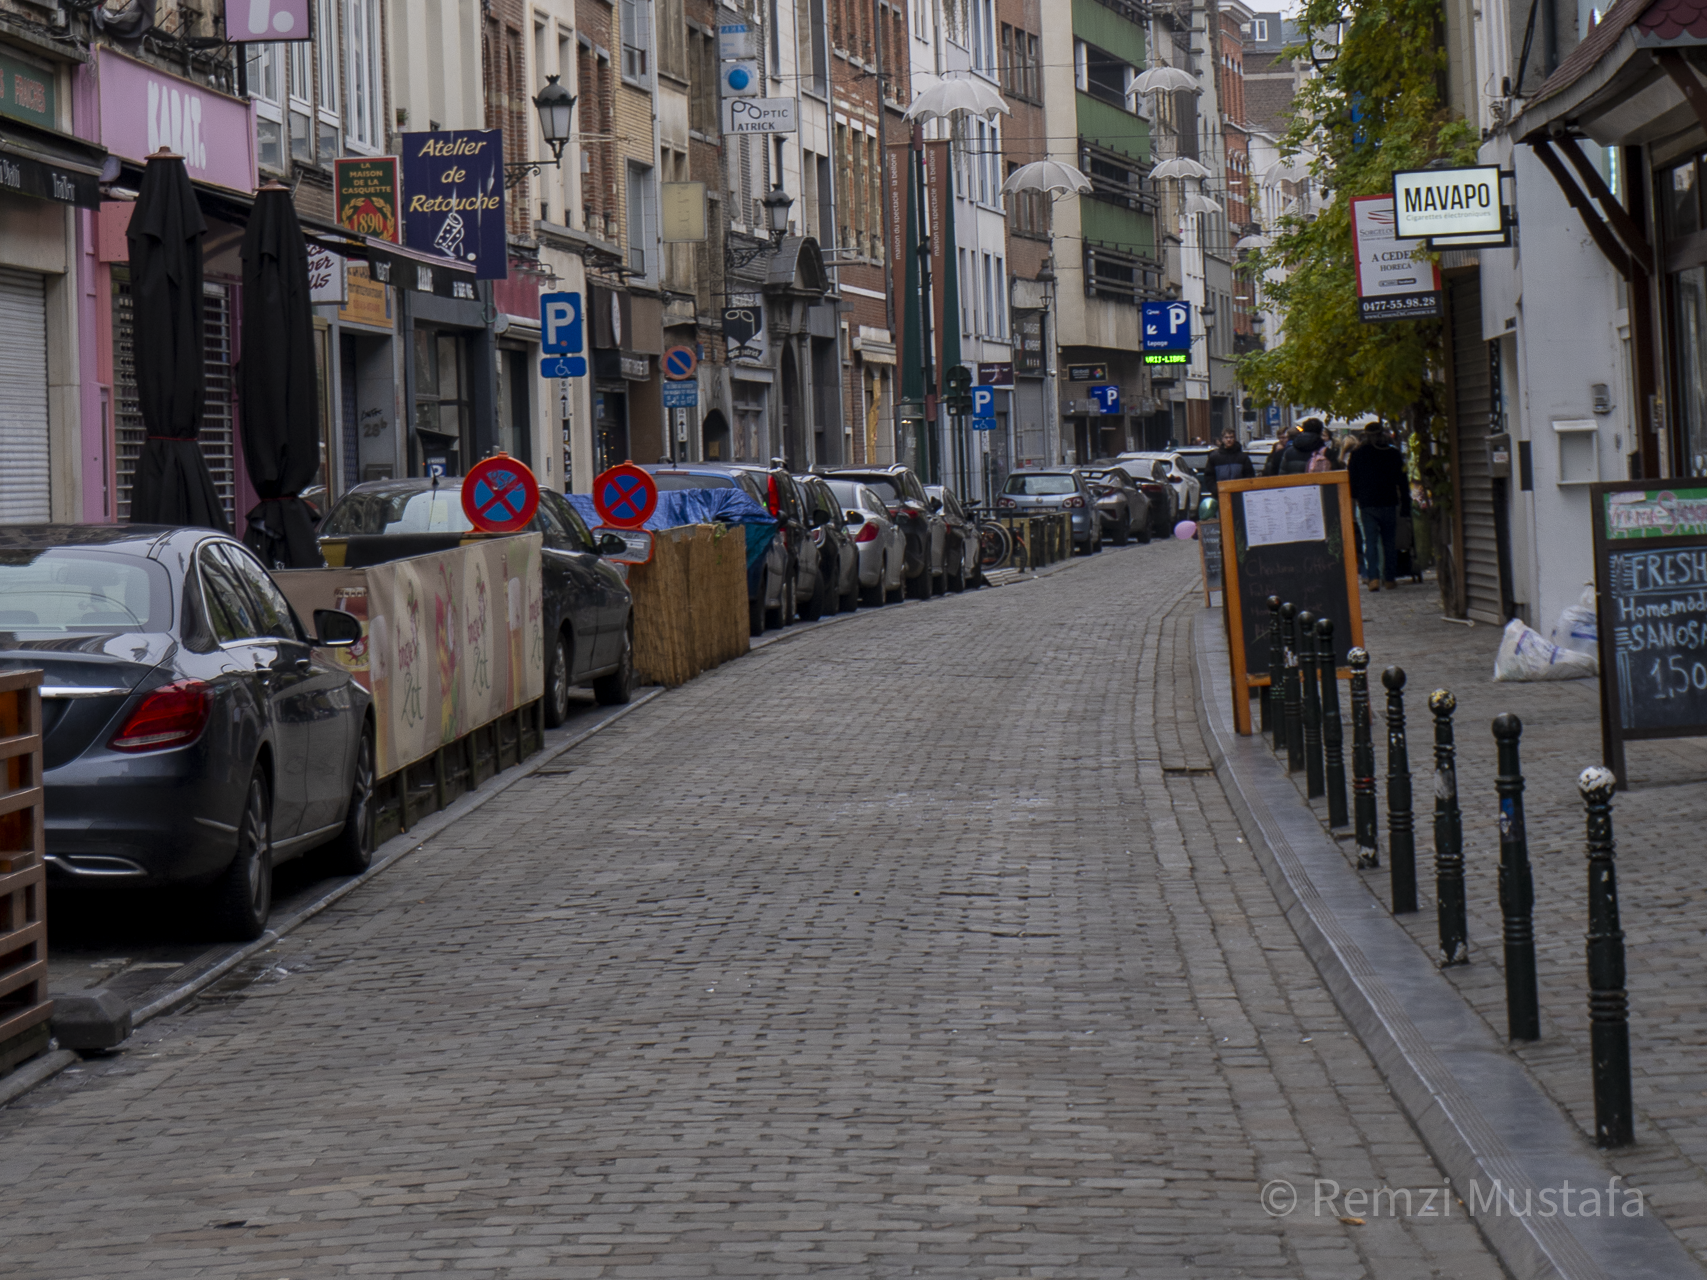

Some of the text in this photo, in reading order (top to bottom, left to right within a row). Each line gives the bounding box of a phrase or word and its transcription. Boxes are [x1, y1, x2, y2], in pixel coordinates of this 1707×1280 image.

[418, 137, 487, 157] Atelier
[350, 170, 383, 178] MAISON
[441, 166, 466, 183] de
[890, 153, 898, 180] bellone
[342, 186, 392, 195] CASQUETTE
[1404, 182, 1490, 213] MAVAPO
[409, 192, 500, 213] Retouche
[892, 191, 900, 221] spectacle
[930, 188, 939, 218] spectacle
[352, 212, 384, 234] 1890
[932, 220, 939, 231] du
[1406, 214, 1442, 222] Cigarettes
[893, 224, 900, 235] du
[892, 236, 901, 260] maison
[931, 232, 940, 257] maison
[1371, 250, 1415, 263] A CEDE
[1380, 262, 1412, 272] HORECA
[1362, 296, 1436, 312] 0477-55.98.28
[547, 302, 576, 345] P
[1169, 308, 1187, 335] P
[975, 391, 991, 413] P
[1107, 390, 1118, 406] P
[1269, 408, 1277, 418] P
[1632, 552, 1707, 590] FRESH
